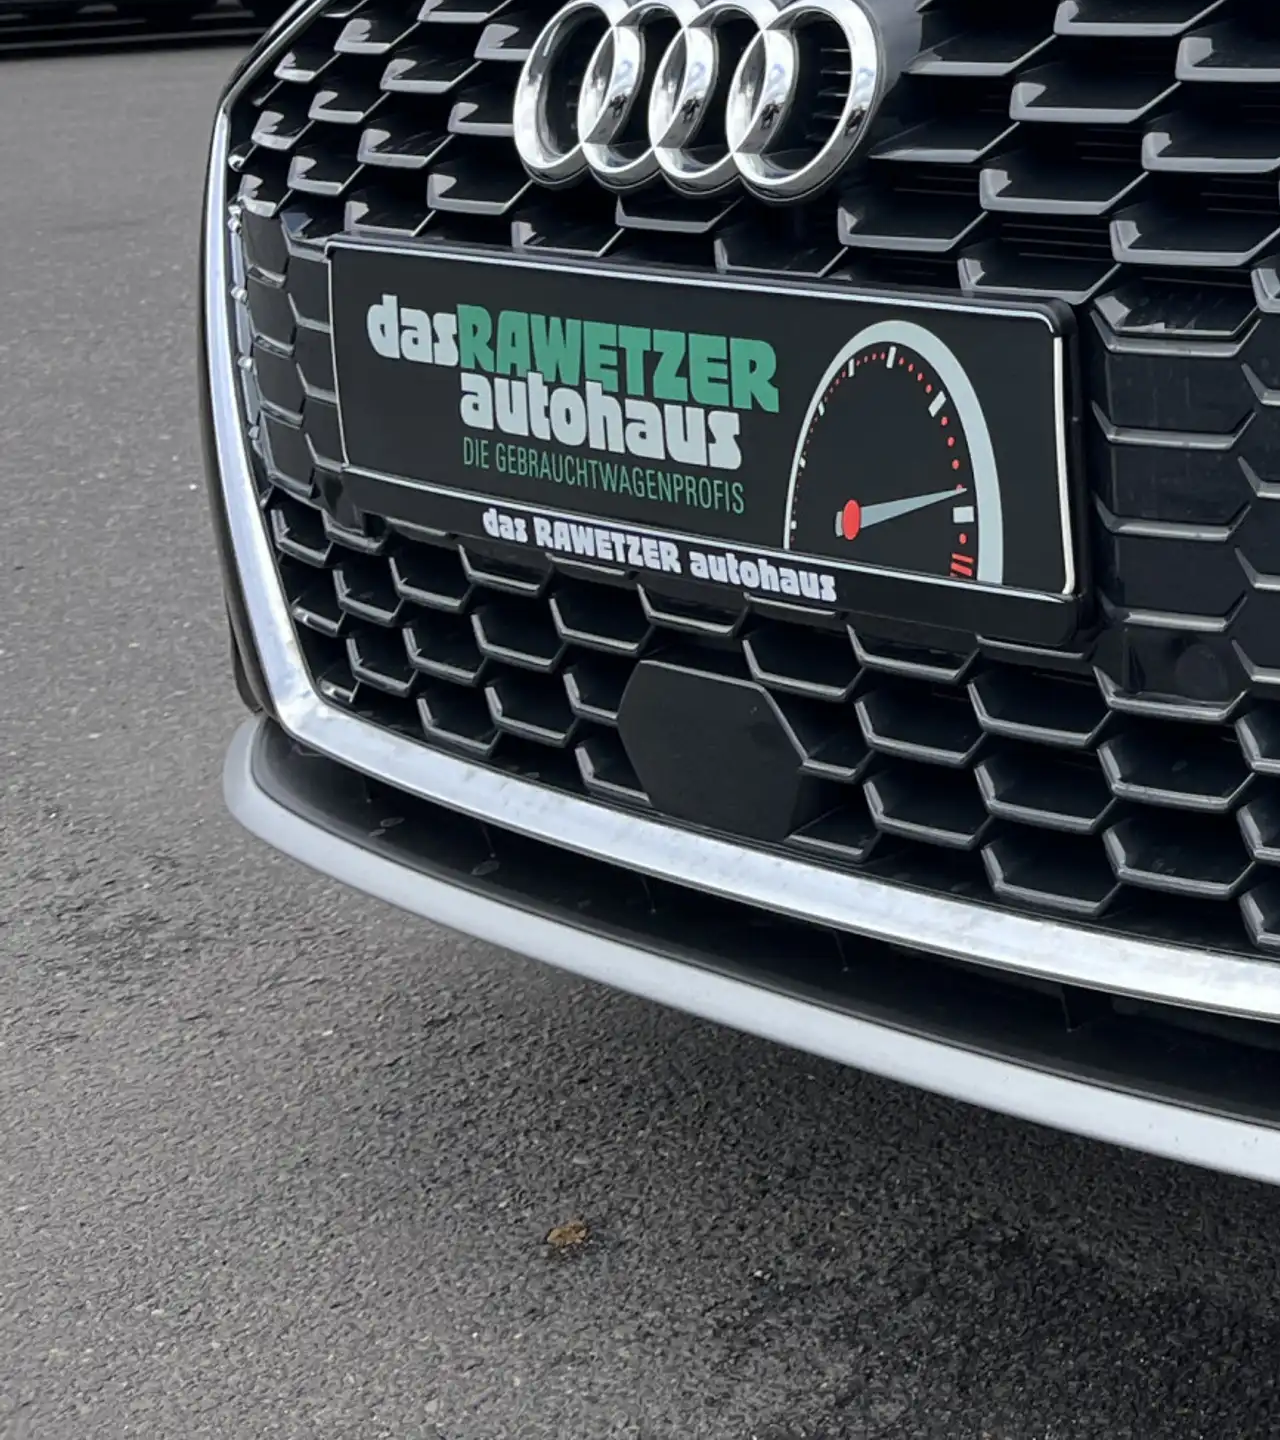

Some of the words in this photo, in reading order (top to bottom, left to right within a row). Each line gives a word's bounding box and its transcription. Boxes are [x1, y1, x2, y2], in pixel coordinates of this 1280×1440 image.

[460, 371, 742, 470] autohaus
[463, 436, 490, 470] DIE
[495, 443, 744, 514] GEBRAUCHTWAGENPROFIS
[482, 508, 528, 543] das
[533, 517, 682, 574] RAWETZER
[689, 550, 838, 602] autohaus
